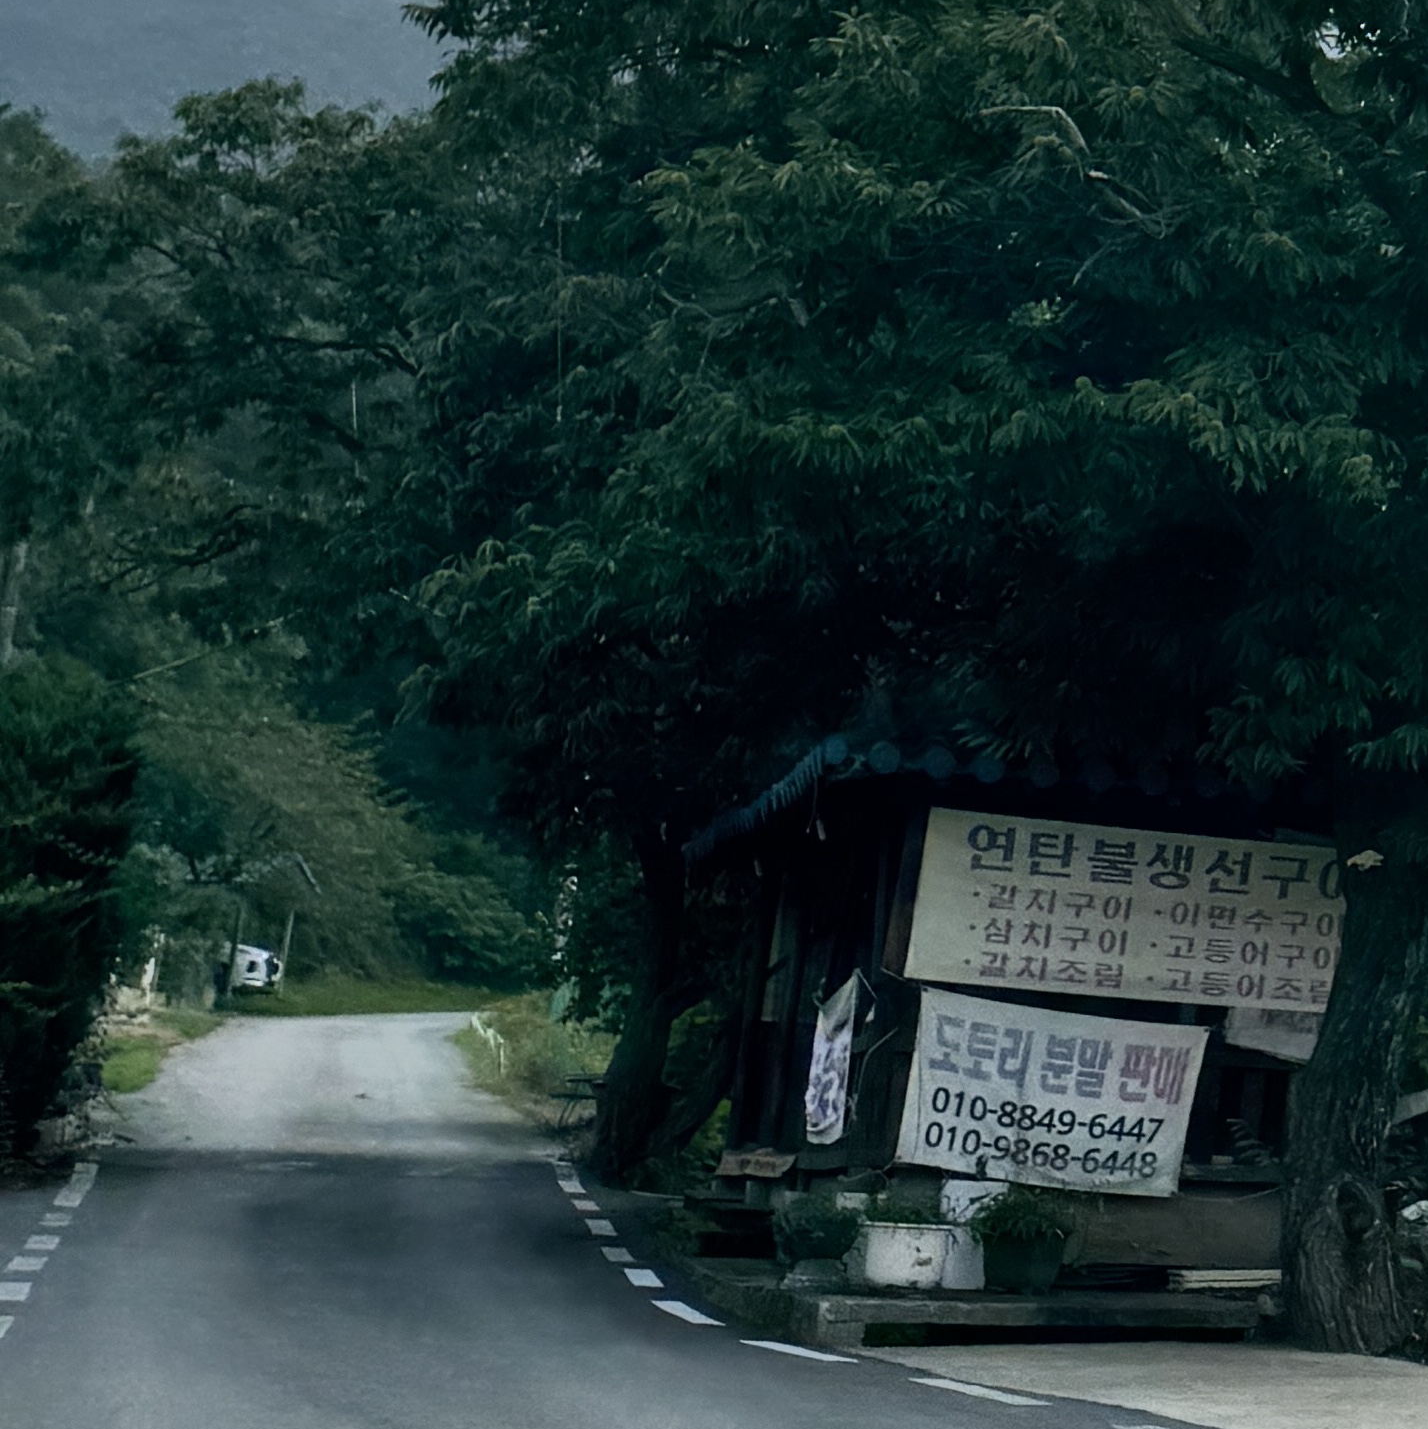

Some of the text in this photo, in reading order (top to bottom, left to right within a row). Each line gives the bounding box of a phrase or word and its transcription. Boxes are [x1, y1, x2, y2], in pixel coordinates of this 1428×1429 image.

[983, 918, 1128, 957] 삼치구이
[928, 1013, 1035, 1088] 도토리
[1040, 1032, 1113, 1100] 분말
[1118, 1042, 1193, 1106] 판매
[931, 1086, 1165, 1144] 010-8849-6447
[924, 1121, 1158, 1179] 010-9868-6448
